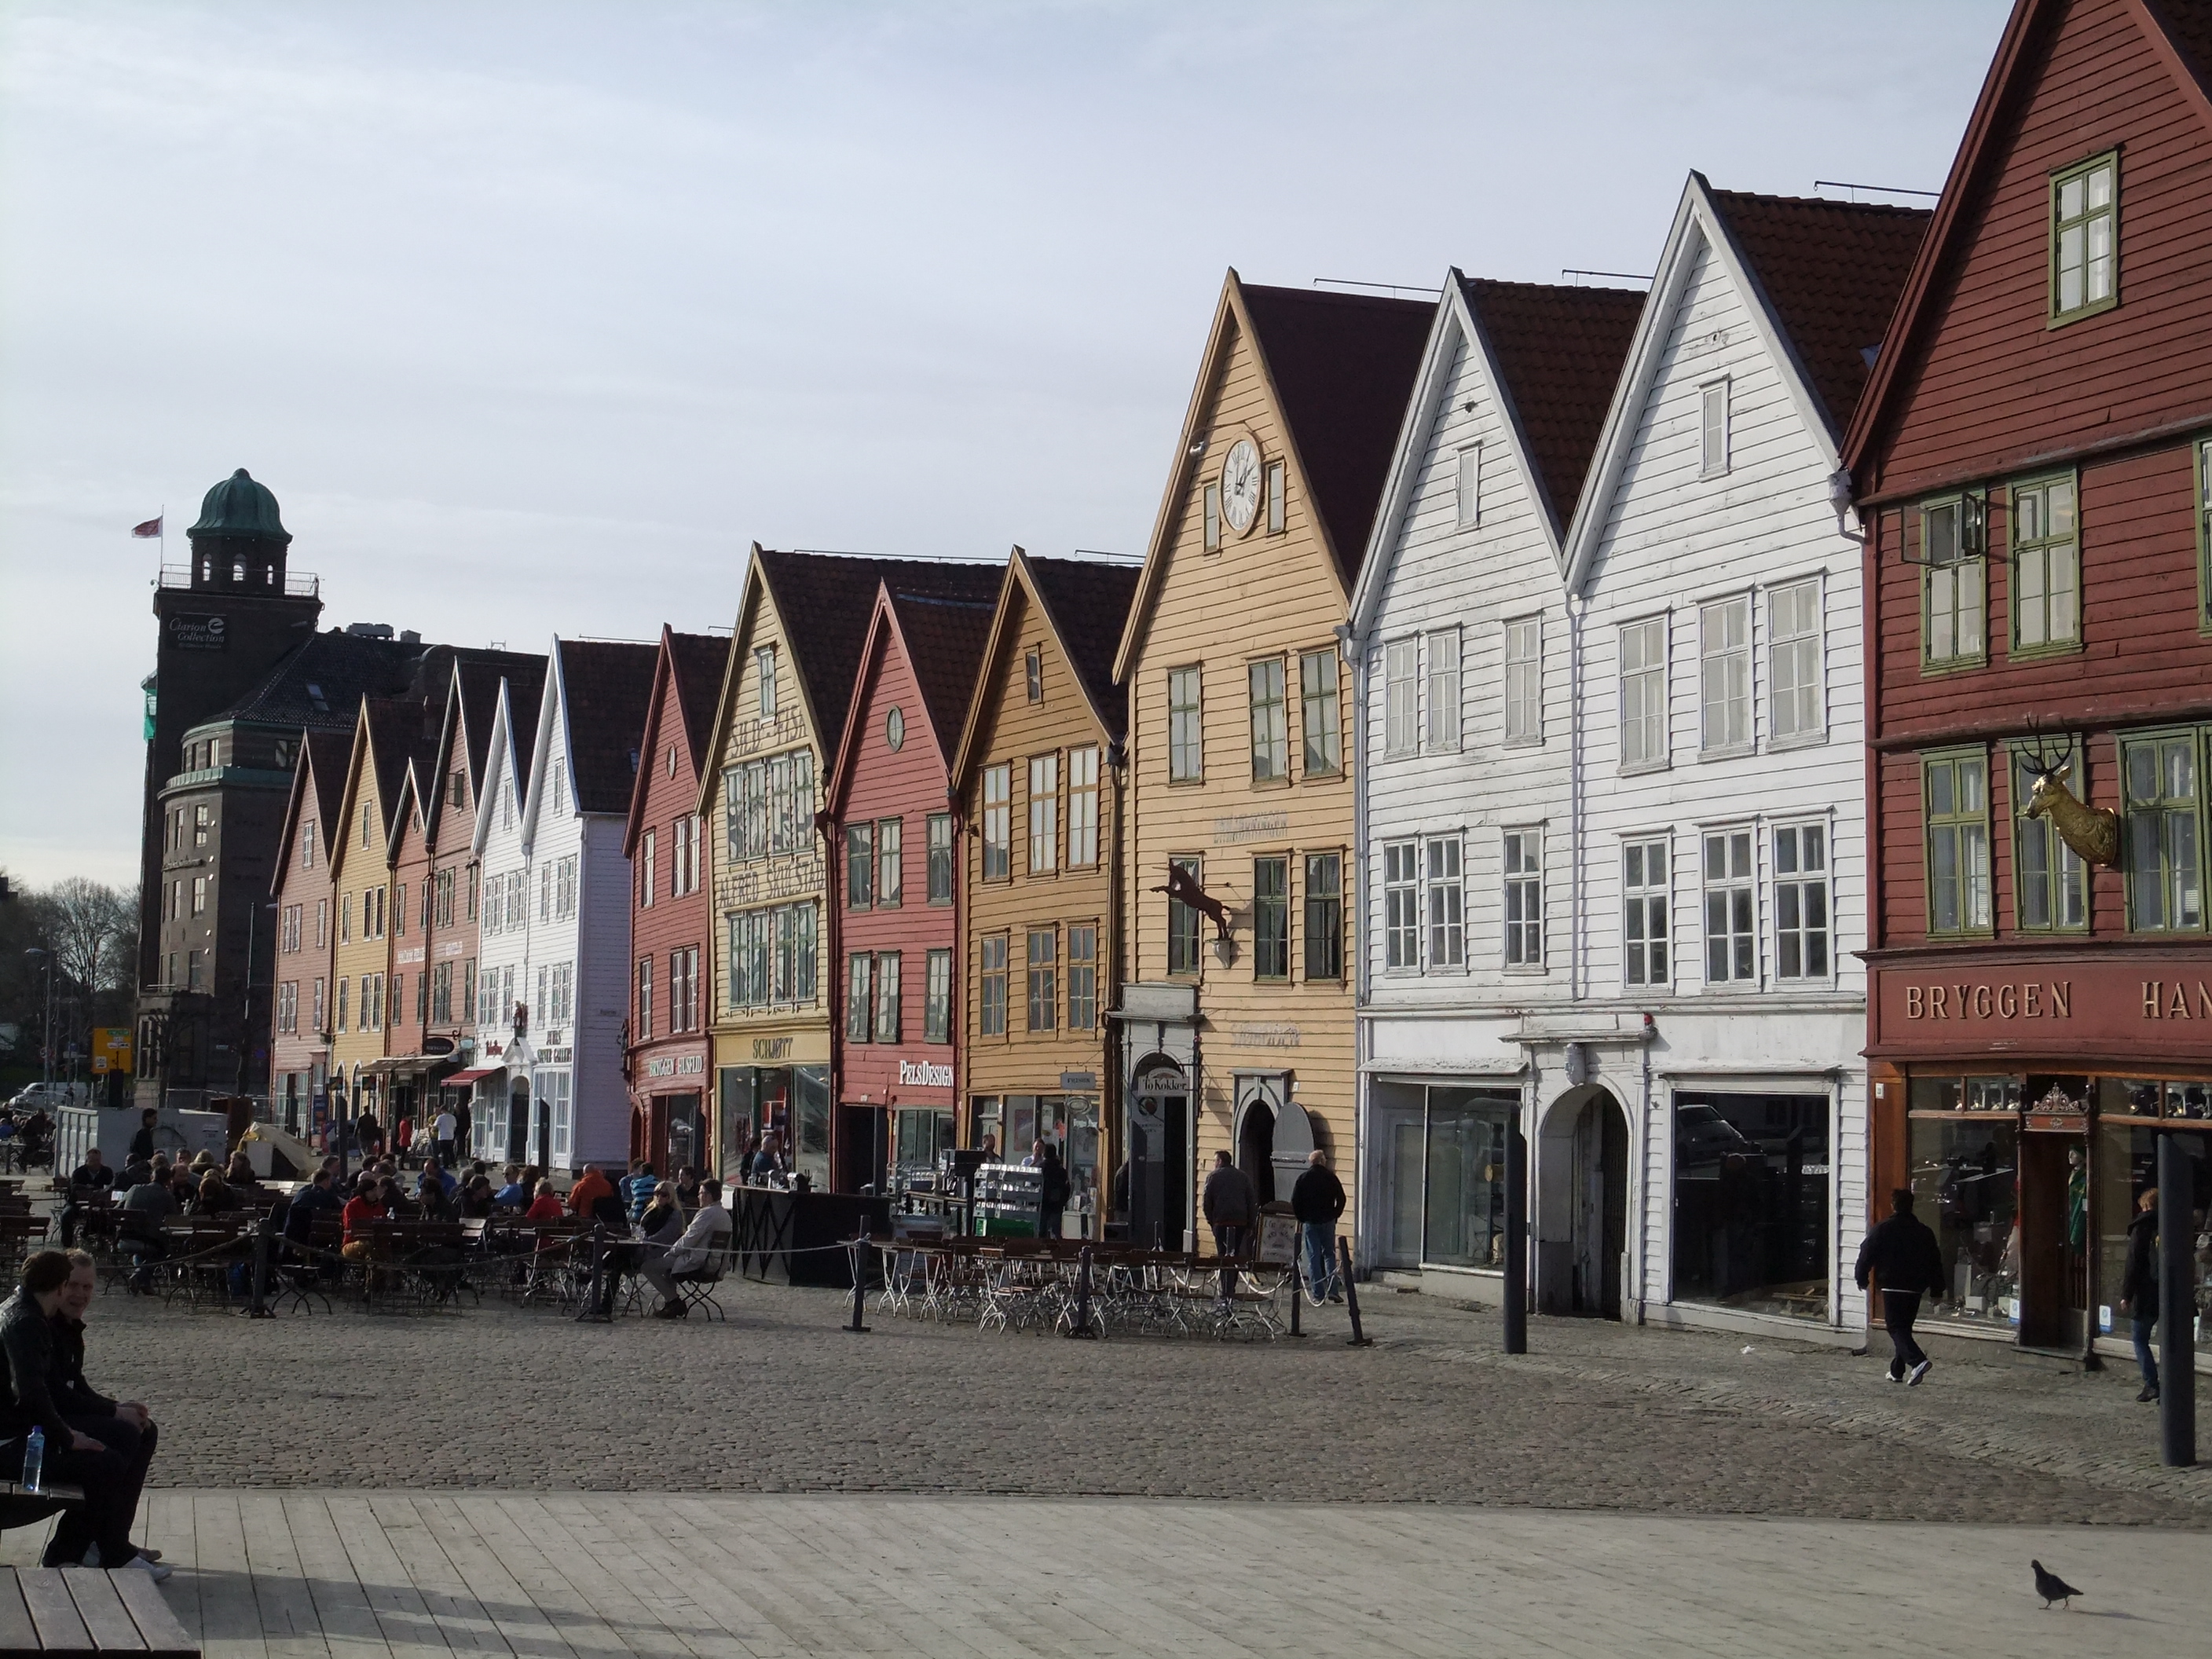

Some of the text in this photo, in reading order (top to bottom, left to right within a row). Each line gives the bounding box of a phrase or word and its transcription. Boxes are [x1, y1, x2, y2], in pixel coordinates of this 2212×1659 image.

[170, 617, 207, 632] Clarion
[178, 632, 225, 643] Collection
[1906, 981, 2071, 1020] BRYGGEN
[649, 1058, 675, 1077] BRYGGEN
[1142, 1079, 1187, 1090] To Kokker
